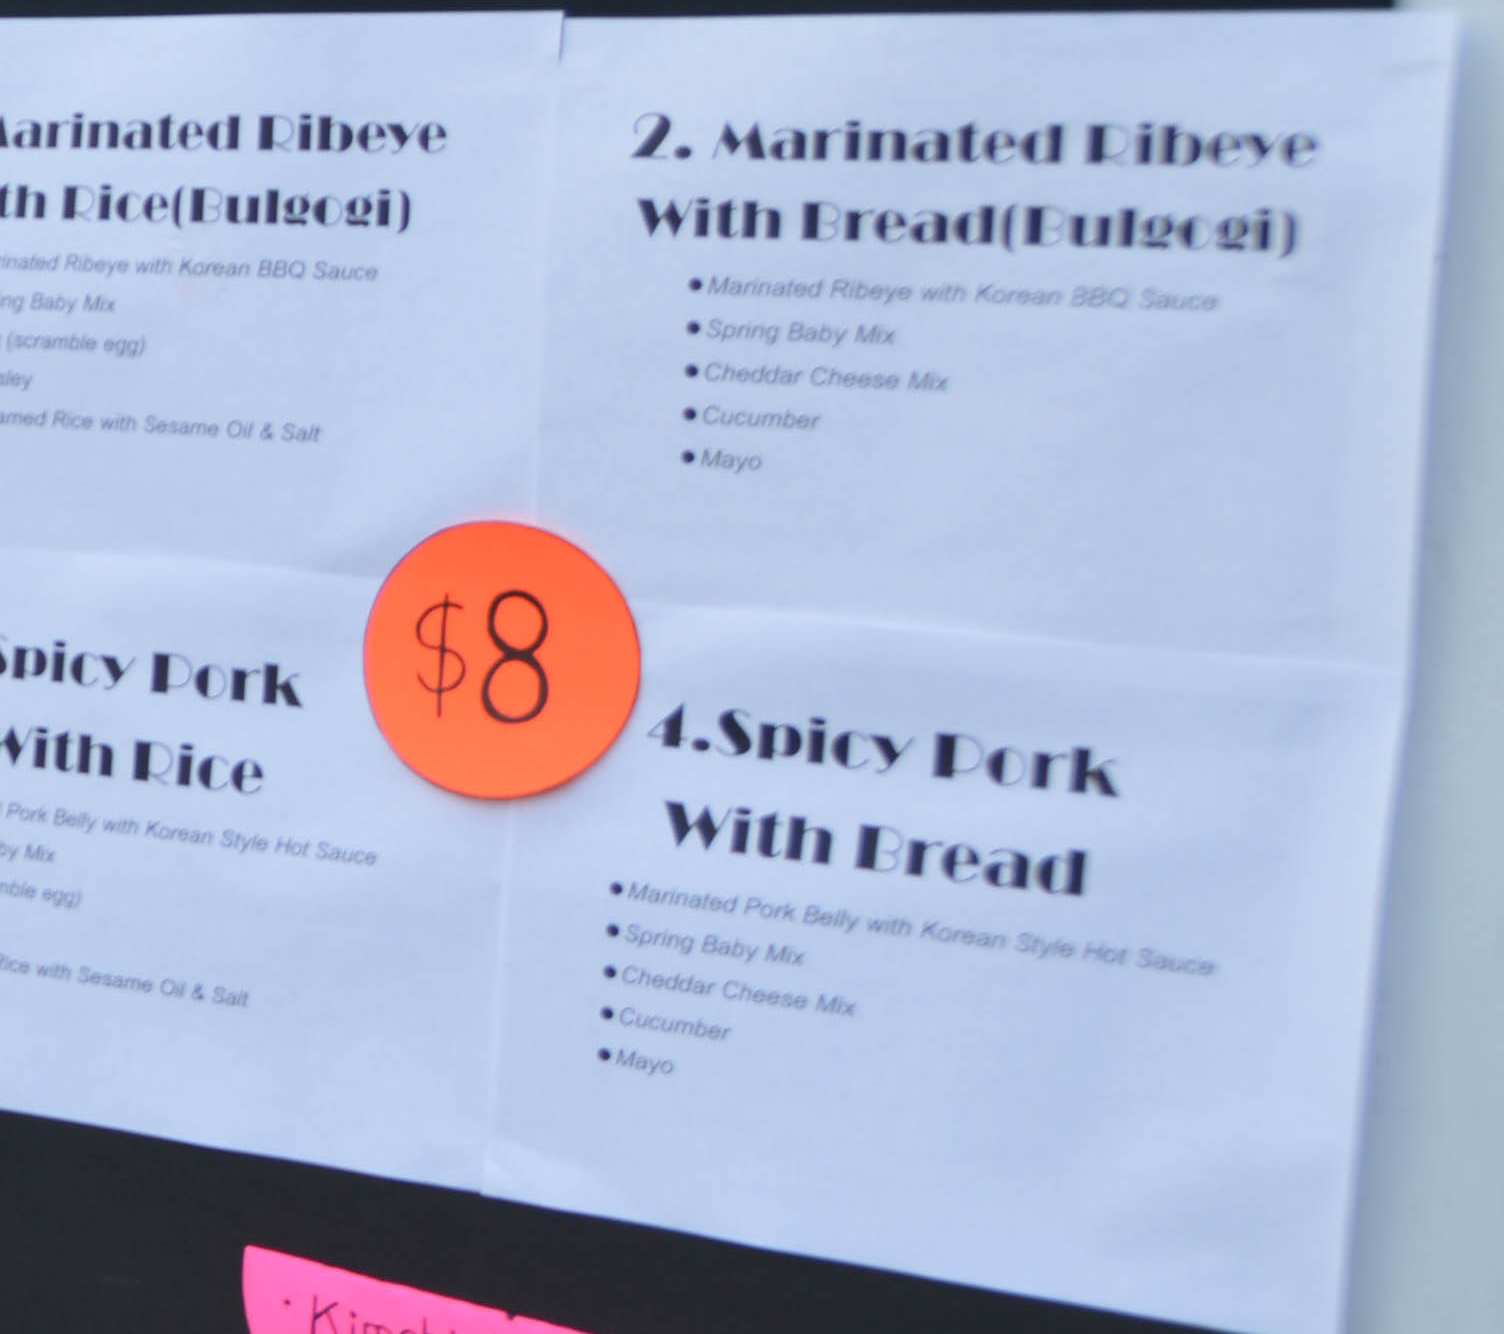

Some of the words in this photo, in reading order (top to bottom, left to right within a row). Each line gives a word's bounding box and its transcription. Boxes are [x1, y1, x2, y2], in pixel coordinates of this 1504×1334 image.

[257, 112, 448, 154] Ribeye
[631, 113, 693, 161] 2.
[714, 119, 1065, 165] Marinated
[1085, 122, 1319, 167] Ribeye
[61, 183, 411, 234] Rice(Bulgogi)
[637, 196, 782, 241] With
[801, 200, 1298, 258] Bread(Bulgogi)
[63, 251, 131, 279] Ribeye
[135, 256, 174, 277] with
[177, 255, 252, 280] Korean
[255, 257, 308, 281] BBQ
[311, 259, 380, 283] Sauce
[28, 290, 78, 317] Baby
[81, 292, 117, 315] Mix
[706, 274, 827, 301] Marinated
[829, 276, 915, 308] Ribeye
[919, 281, 969, 304] with
[973, 282, 1065, 308] Korean
[1069, 283, 1133, 311] BBQ
[1138, 286, 1221, 313] Sauce
[705, 316, 782, 348] Spring
[786, 320, 849, 349] Baby
[853, 323, 897, 347] Mix
[702, 359, 805, 387] Cheddar
[809, 365, 902, 392] Cheese
[905, 369, 950, 394] Mix
[51, 408, 95, 432] Rice
[99, 413, 139, 434] with
[143, 413, 221, 439] Sesame
[225, 418, 255, 441] Oil
[258, 420, 276, 443] &
[280, 421, 323, 445] Salt
[701, 402, 823, 432] Cucumber
[699, 446, 764, 476] Mayo
[414, 587, 549, 725] $8
[150, 651, 303, 709] Pork
[132, 739, 264, 794] Rice
[649, 702, 913, 774] 4.Spicy
[932, 731, 1119, 799] Pork
[5, 800, 49, 825] Pork
[52, 806, 98, 835] Belly
[102, 817, 141, 836] with
[143, 819, 215, 847] Korean
[219, 827, 271, 855] Style
[273, 835, 312, 859] Hot
[314, 839, 379, 868] Sauce
[23, 841, 57, 865] Mix
[665, 799, 834, 867] With
[855, 823, 1089, 898] Bread
[623, 922, 696, 957] Spring
[700, 932, 760, 965] Baby
[763, 941, 806, 968] Mix
[624, 880, 740, 916] Marinated
[742, 895, 797, 924] Pork
[801, 902, 862, 936] Belly
[865, 916, 914, 938] with
[919, 919, 1009, 951] Korean
[1015, 930, 1078, 962] Style
[1081, 941, 1131, 967] Hot
[1135, 946, 1221, 979] Sauce
[35, 961, 73, 982] with
[76, 964, 155, 995] Sesame
[159, 977, 188, 999] Oil
[189, 981, 206, 1003] &
[211, 984, 251, 1011] Salt
[621, 963, 718, 997] Cheddar
[721, 978, 810, 1012] Cheese
[814, 991, 857, 1018] Mix
[615, 1005, 733, 1043] Cucumber
[614, 1047, 676, 1077] Mayo
